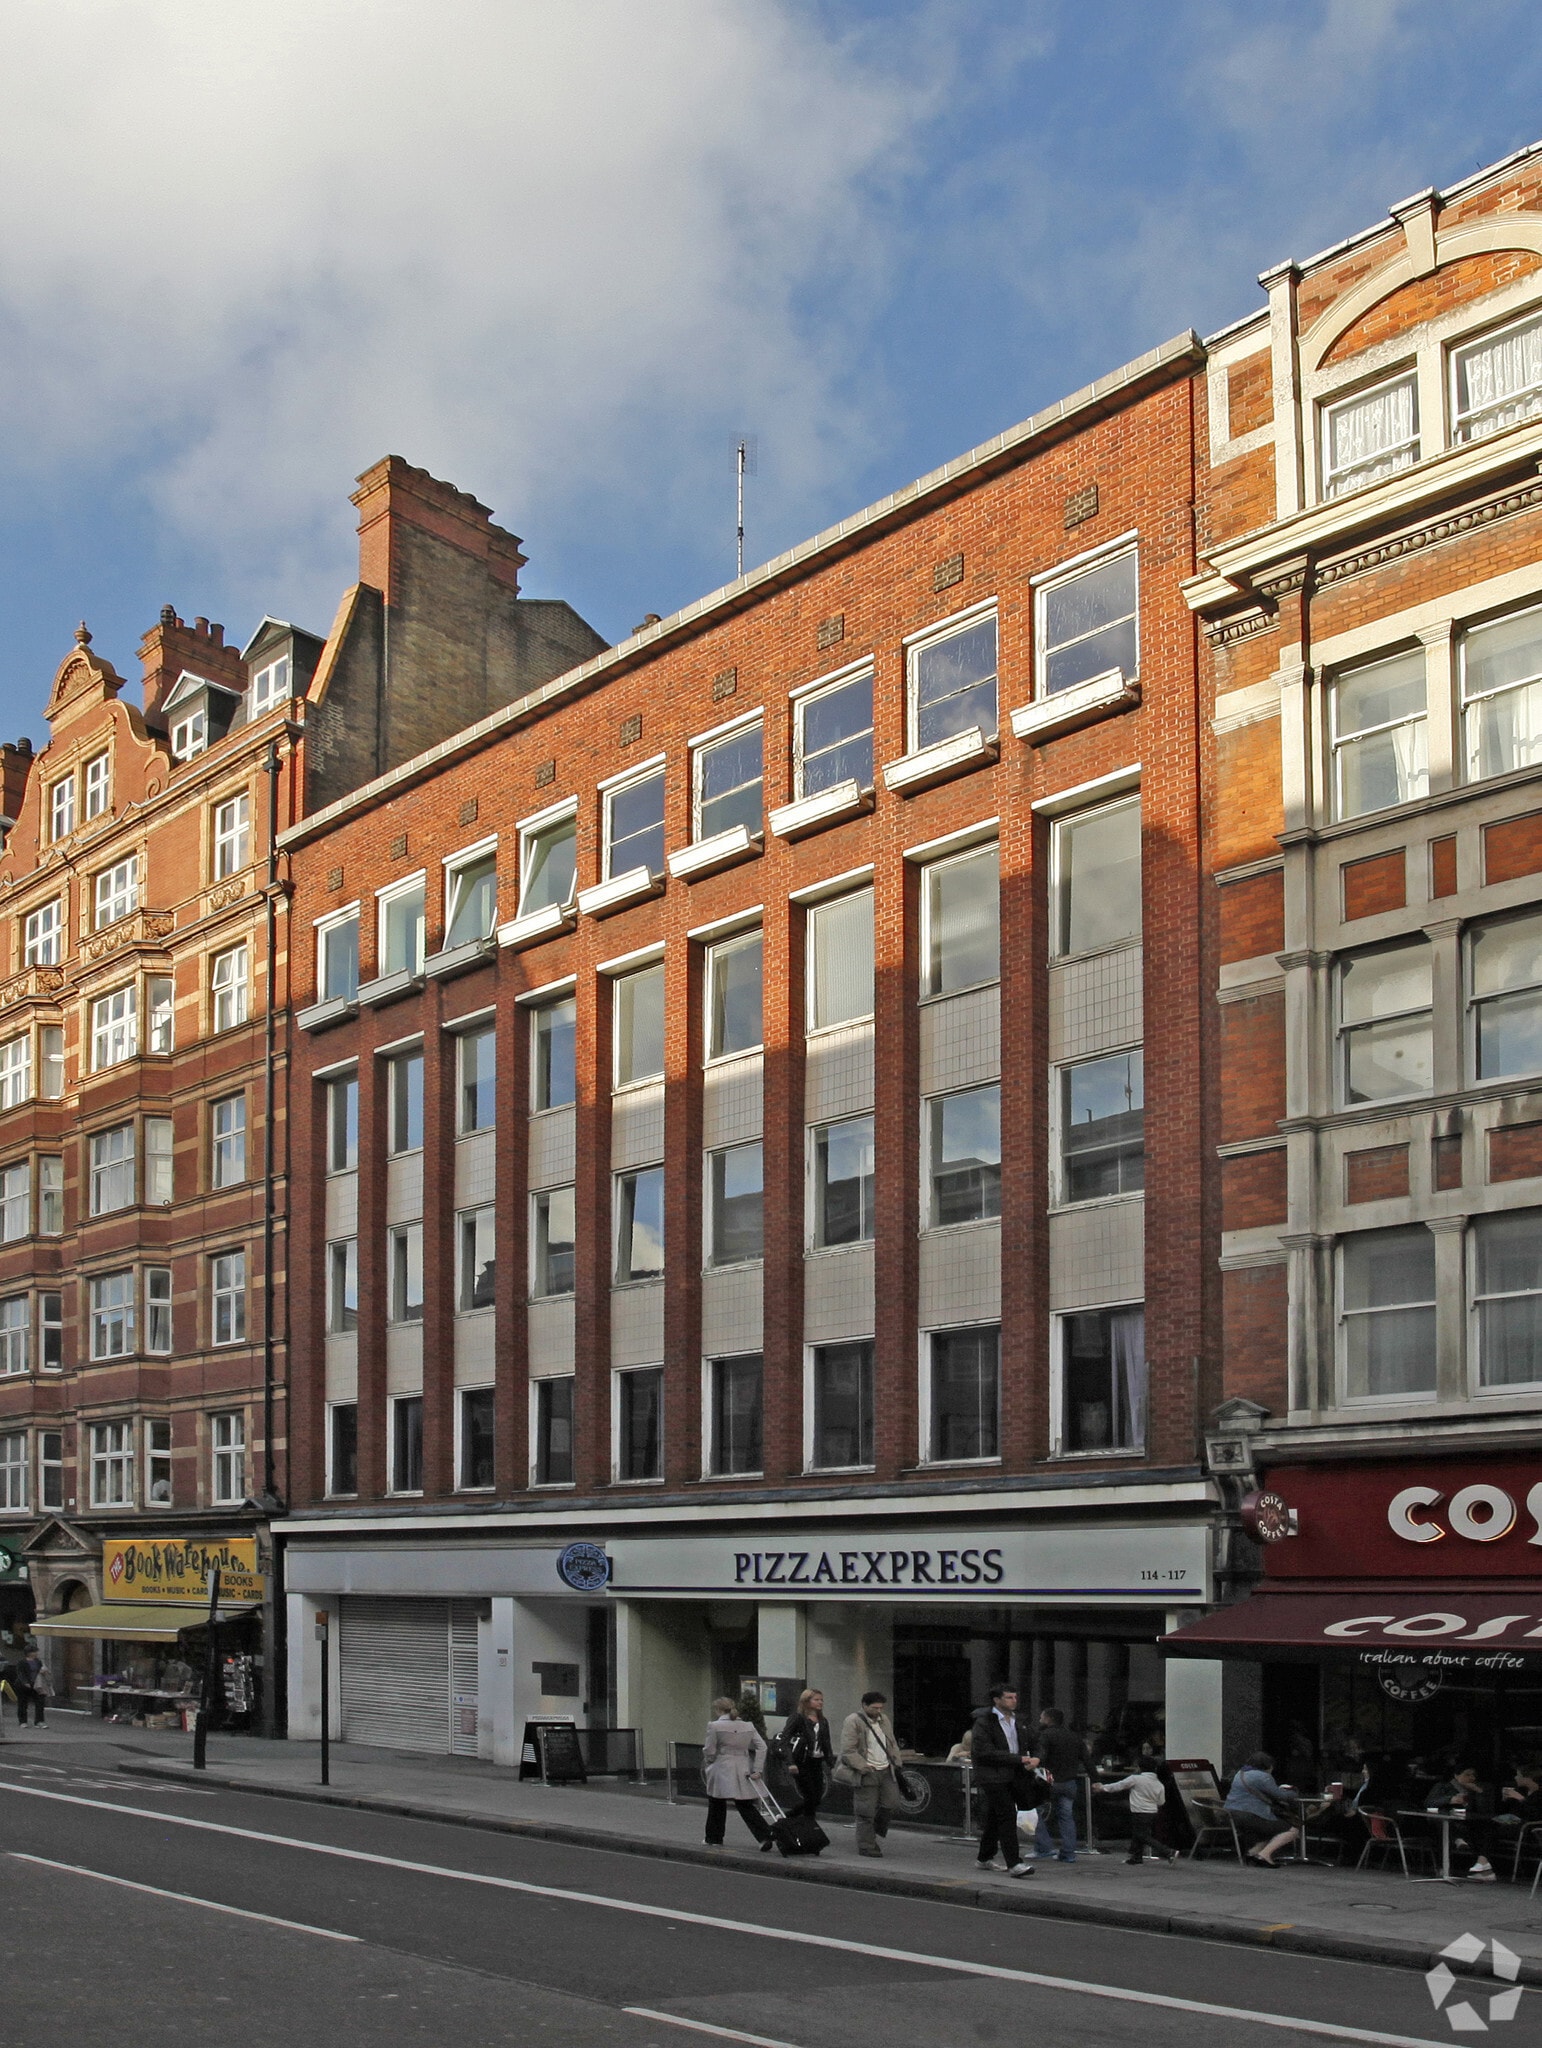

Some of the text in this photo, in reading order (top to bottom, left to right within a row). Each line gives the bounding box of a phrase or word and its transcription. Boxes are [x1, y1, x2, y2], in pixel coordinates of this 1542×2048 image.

[1260, 1495, 1283, 1511] COSTA
[1258, 1520, 1286, 1539] COFFEE
[124, 1544, 163, 1583] Book
[733, 1549, 1003, 1584] PIZZAEXPRESS
[224, 1575, 254, 1587] BOOKS
[141, 1586, 209, 1595] BOOKS MUSIC CARD
[242, 1590, 263, 1600] CARDS
[1422, 1650, 1470, 1666] about
[1474, 1652, 1526, 1668] coffee
[1383, 1678, 1438, 1700] COFFEE
